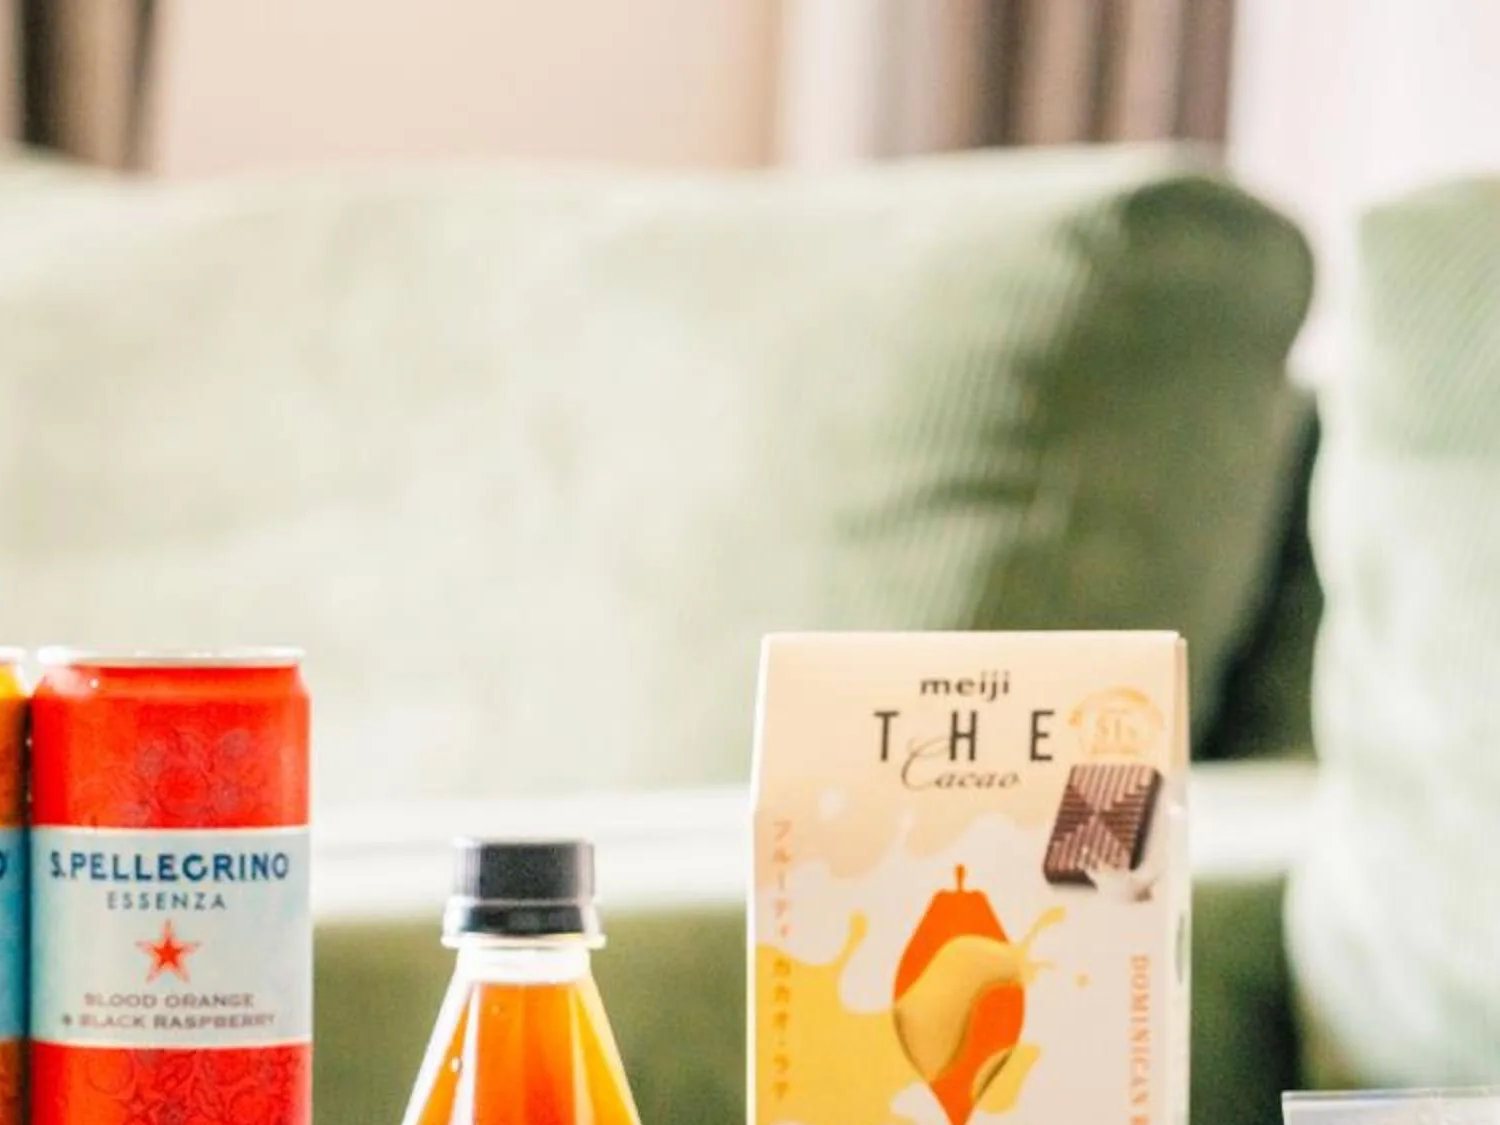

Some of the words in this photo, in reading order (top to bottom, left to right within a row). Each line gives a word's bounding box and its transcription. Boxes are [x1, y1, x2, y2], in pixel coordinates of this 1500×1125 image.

[920, 670, 1010, 702] meiji
[874, 710, 1055, 762] THE
[900, 736, 1020, 791] Cacao
[51, 850, 290, 881] S.PELLEGRINO
[107, 891, 227, 911] ESSENZA
[85, 993, 157, 1009] BLOOD
[164, 993, 255, 1009] ORANGE
[79, 1013, 148, 1030] BLACK
[153, 1013, 276, 1030] RASPBERRY
